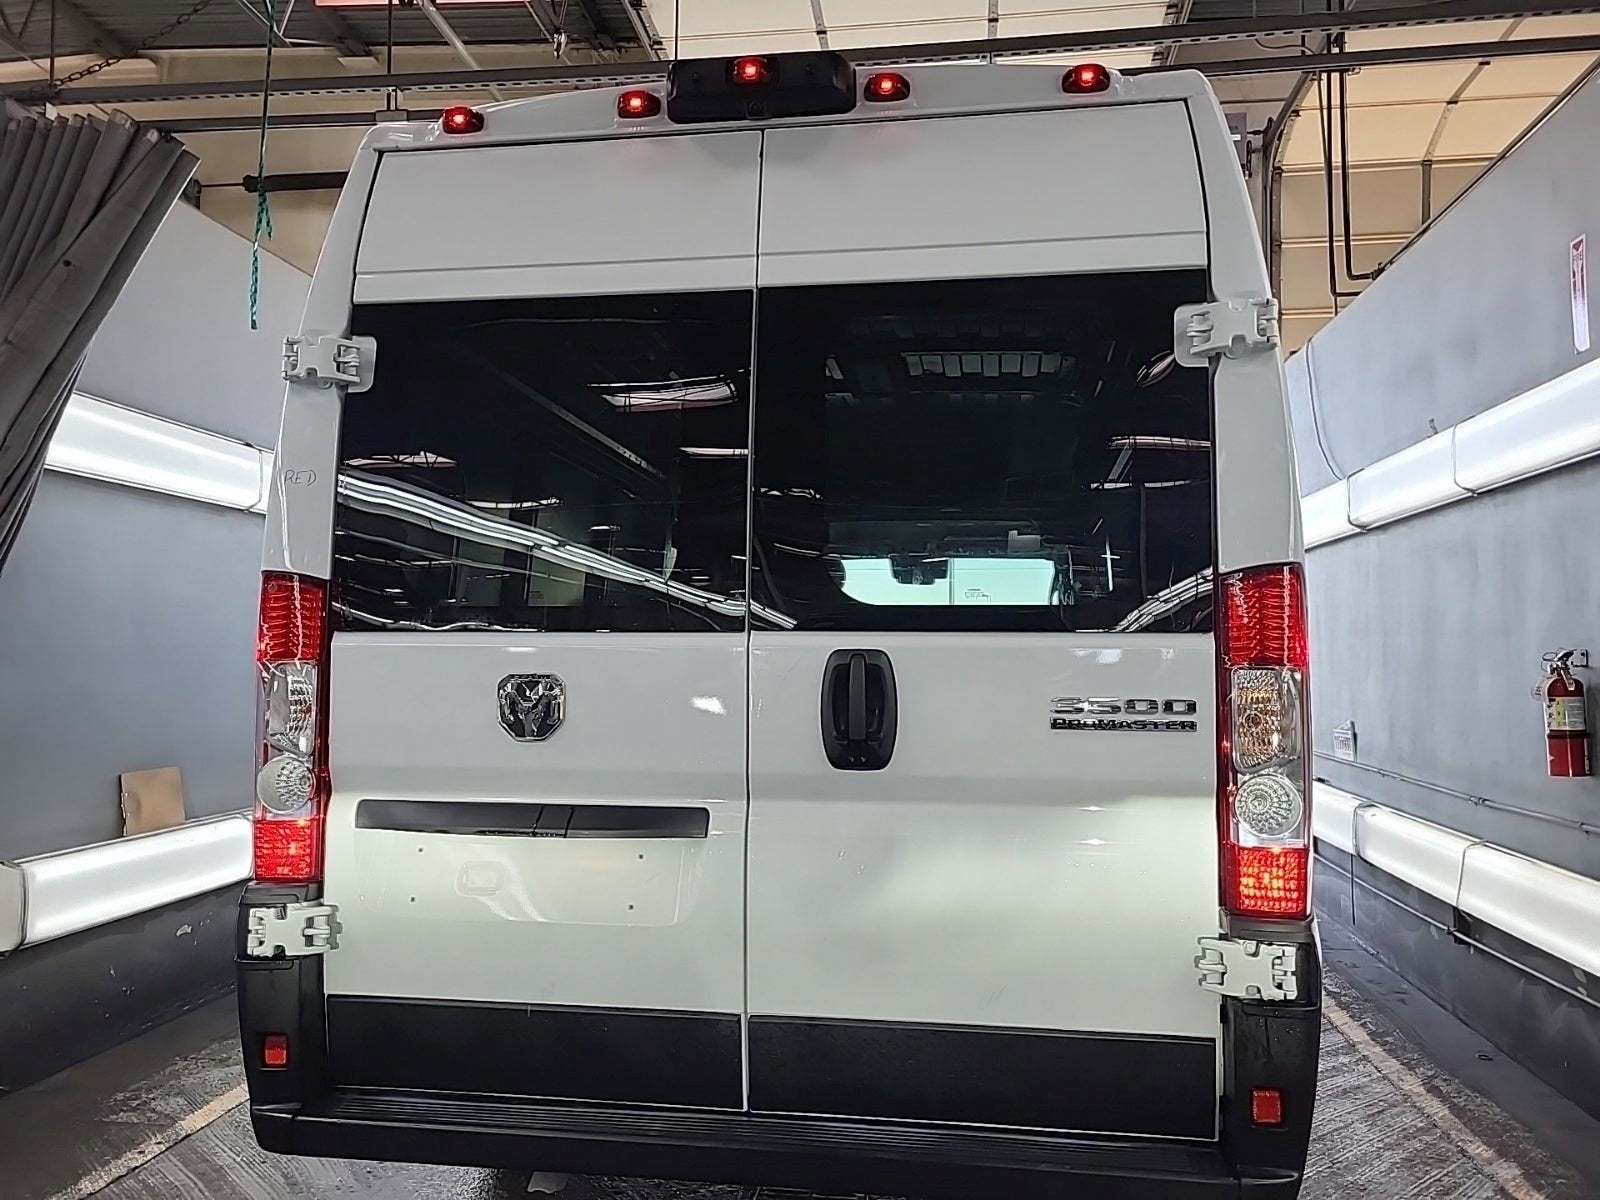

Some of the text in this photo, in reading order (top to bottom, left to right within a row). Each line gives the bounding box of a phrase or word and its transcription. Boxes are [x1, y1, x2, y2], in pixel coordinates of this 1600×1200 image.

[284, 469, 317, 487] RED
[1050, 697, 1197, 715] 3500
[1050, 717, 1197, 732] PROMASTER
